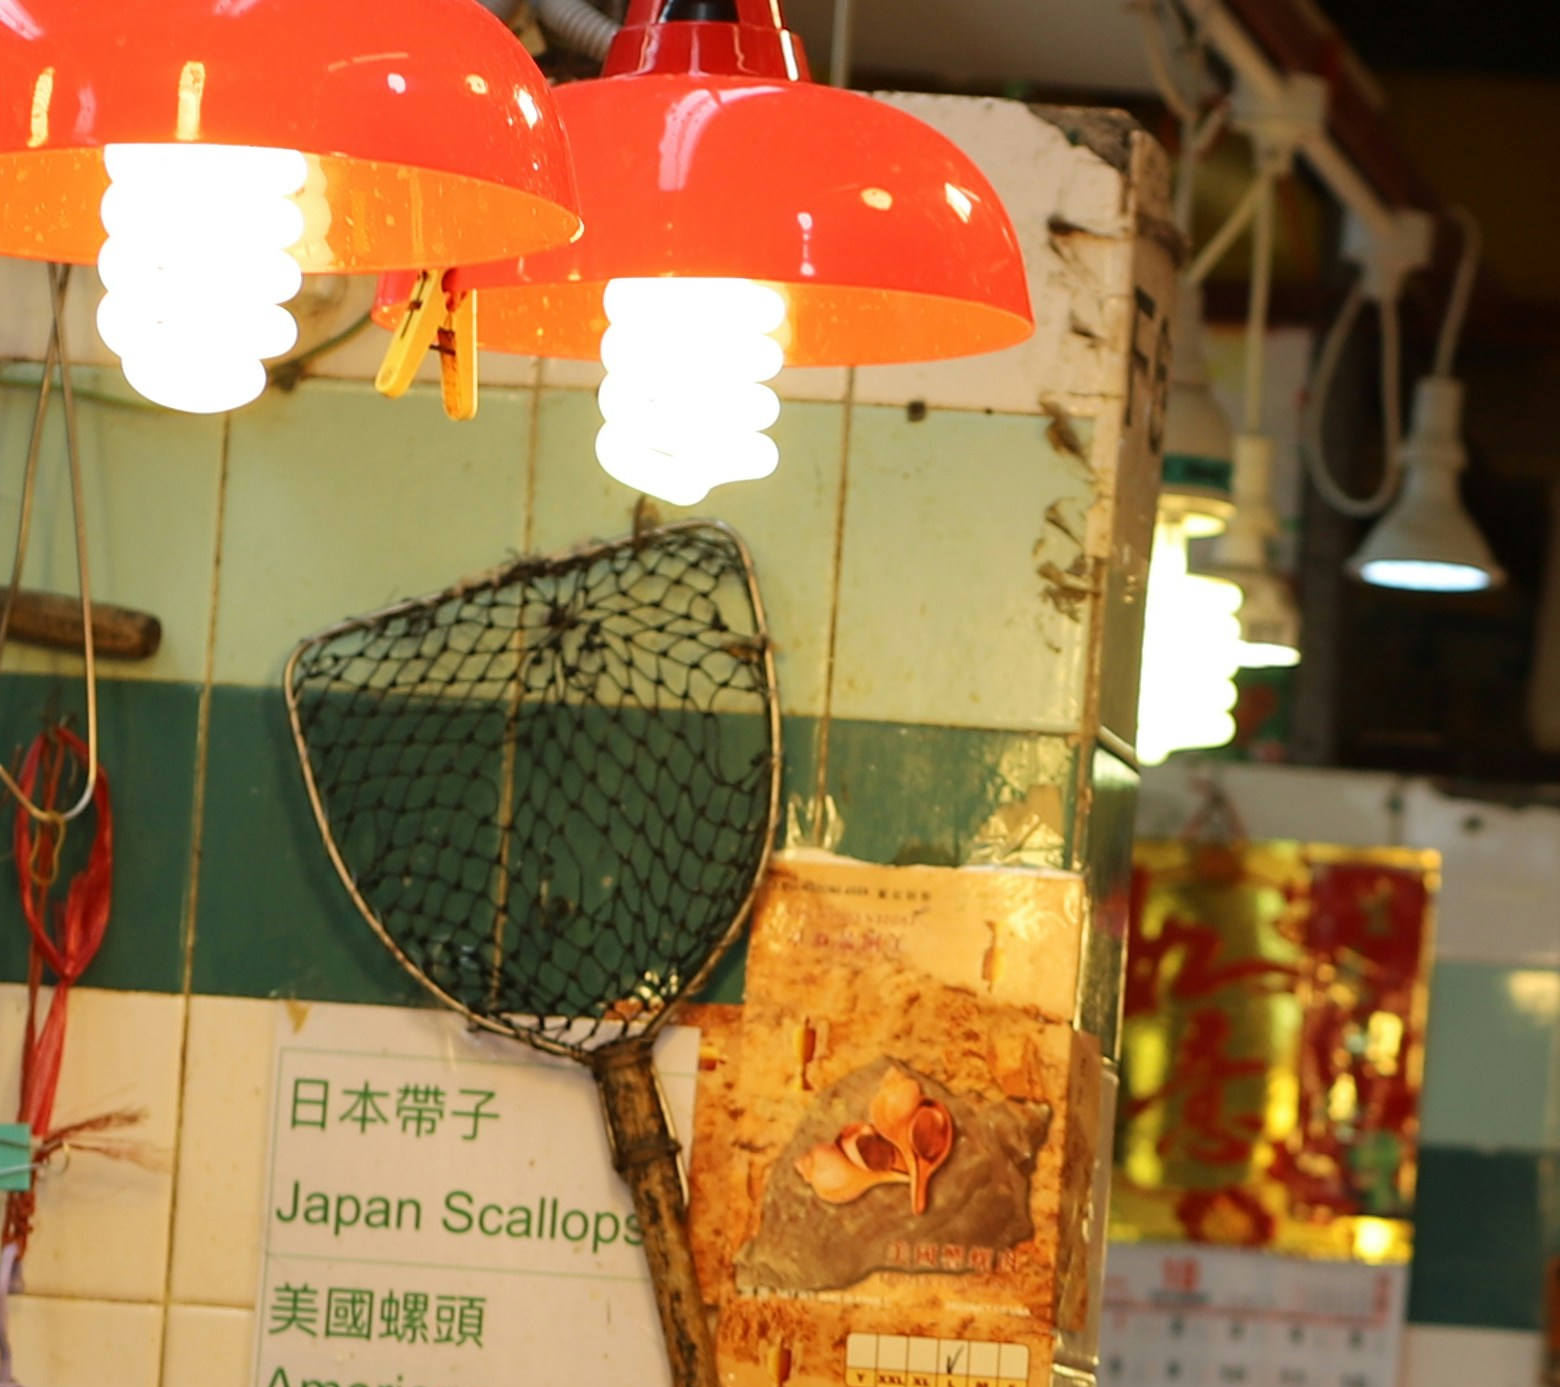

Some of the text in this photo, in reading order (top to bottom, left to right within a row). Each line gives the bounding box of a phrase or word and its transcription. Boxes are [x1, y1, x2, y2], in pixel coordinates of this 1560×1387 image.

[290, 1077, 501, 1141] 日本帶子
[275, 1180, 423, 1237] Japan
[268, 1282, 487, 1348] 美國螺頭
[879, 1375, 903, 1386] XXL
[913, 1376, 930, 1387] XL
